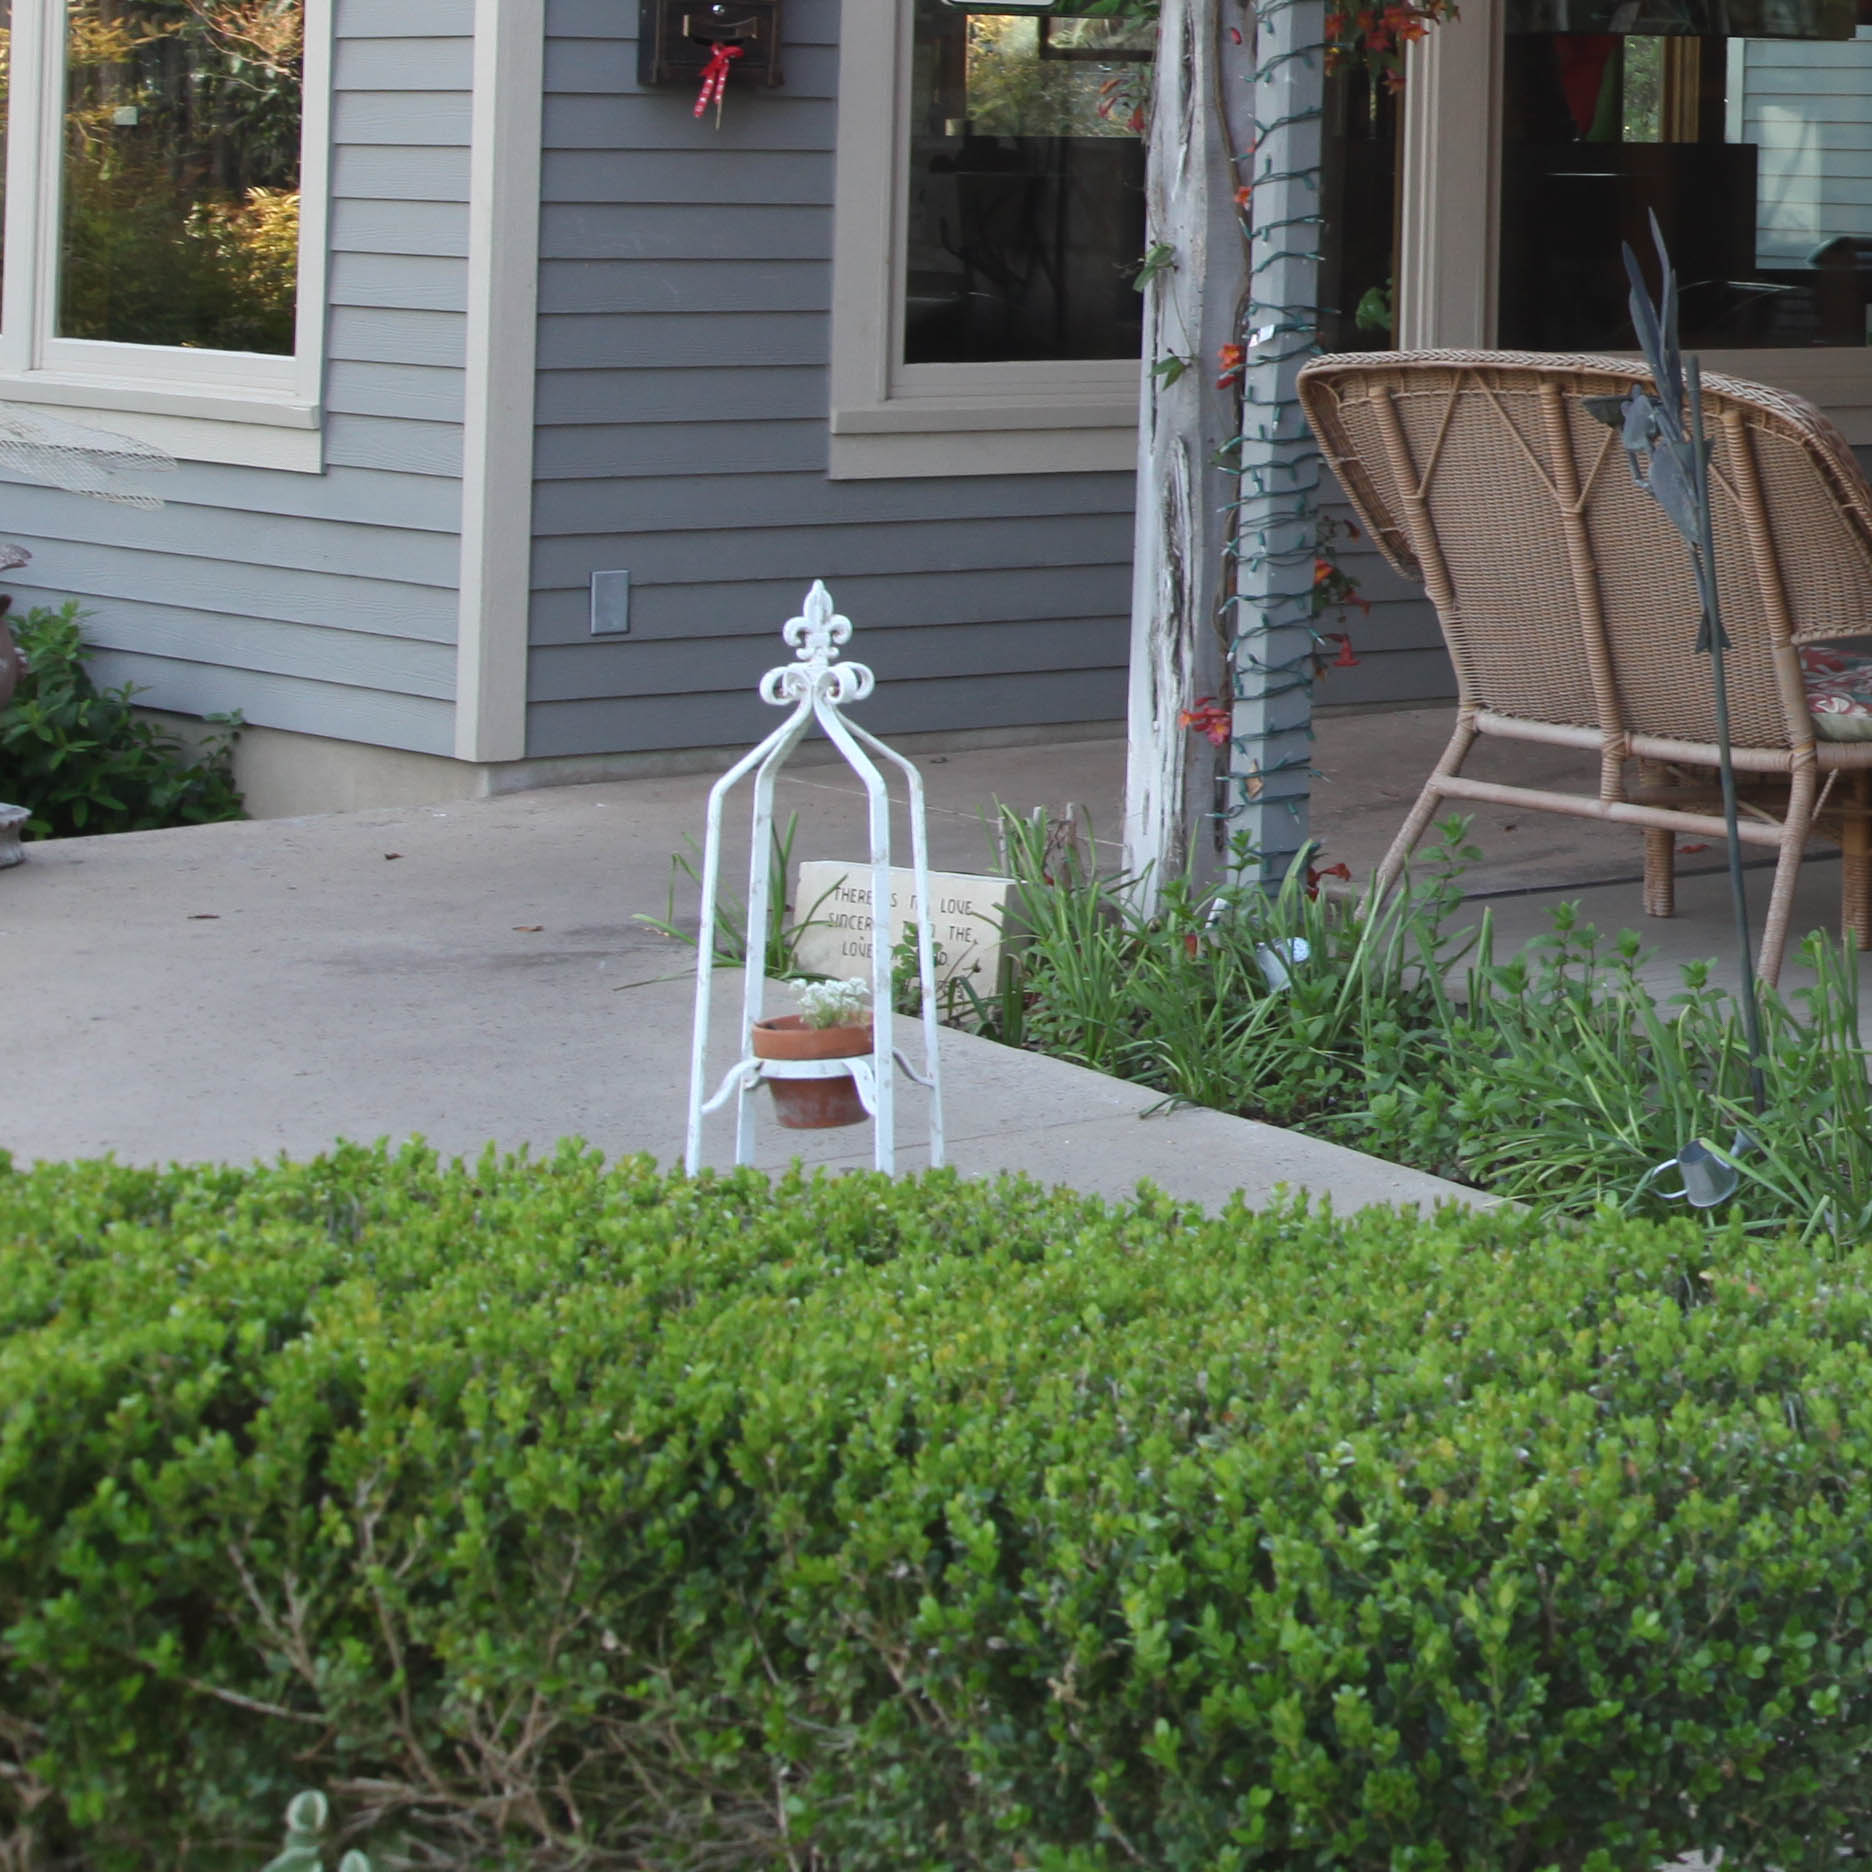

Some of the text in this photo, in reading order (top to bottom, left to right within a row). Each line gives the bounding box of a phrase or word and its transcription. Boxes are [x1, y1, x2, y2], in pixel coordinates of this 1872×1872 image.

[834, 886, 872, 905] THERE
[941, 897, 974, 916] LOVE
[950, 925, 972, 943] THE
[843, 940, 873, 960] LOVE
